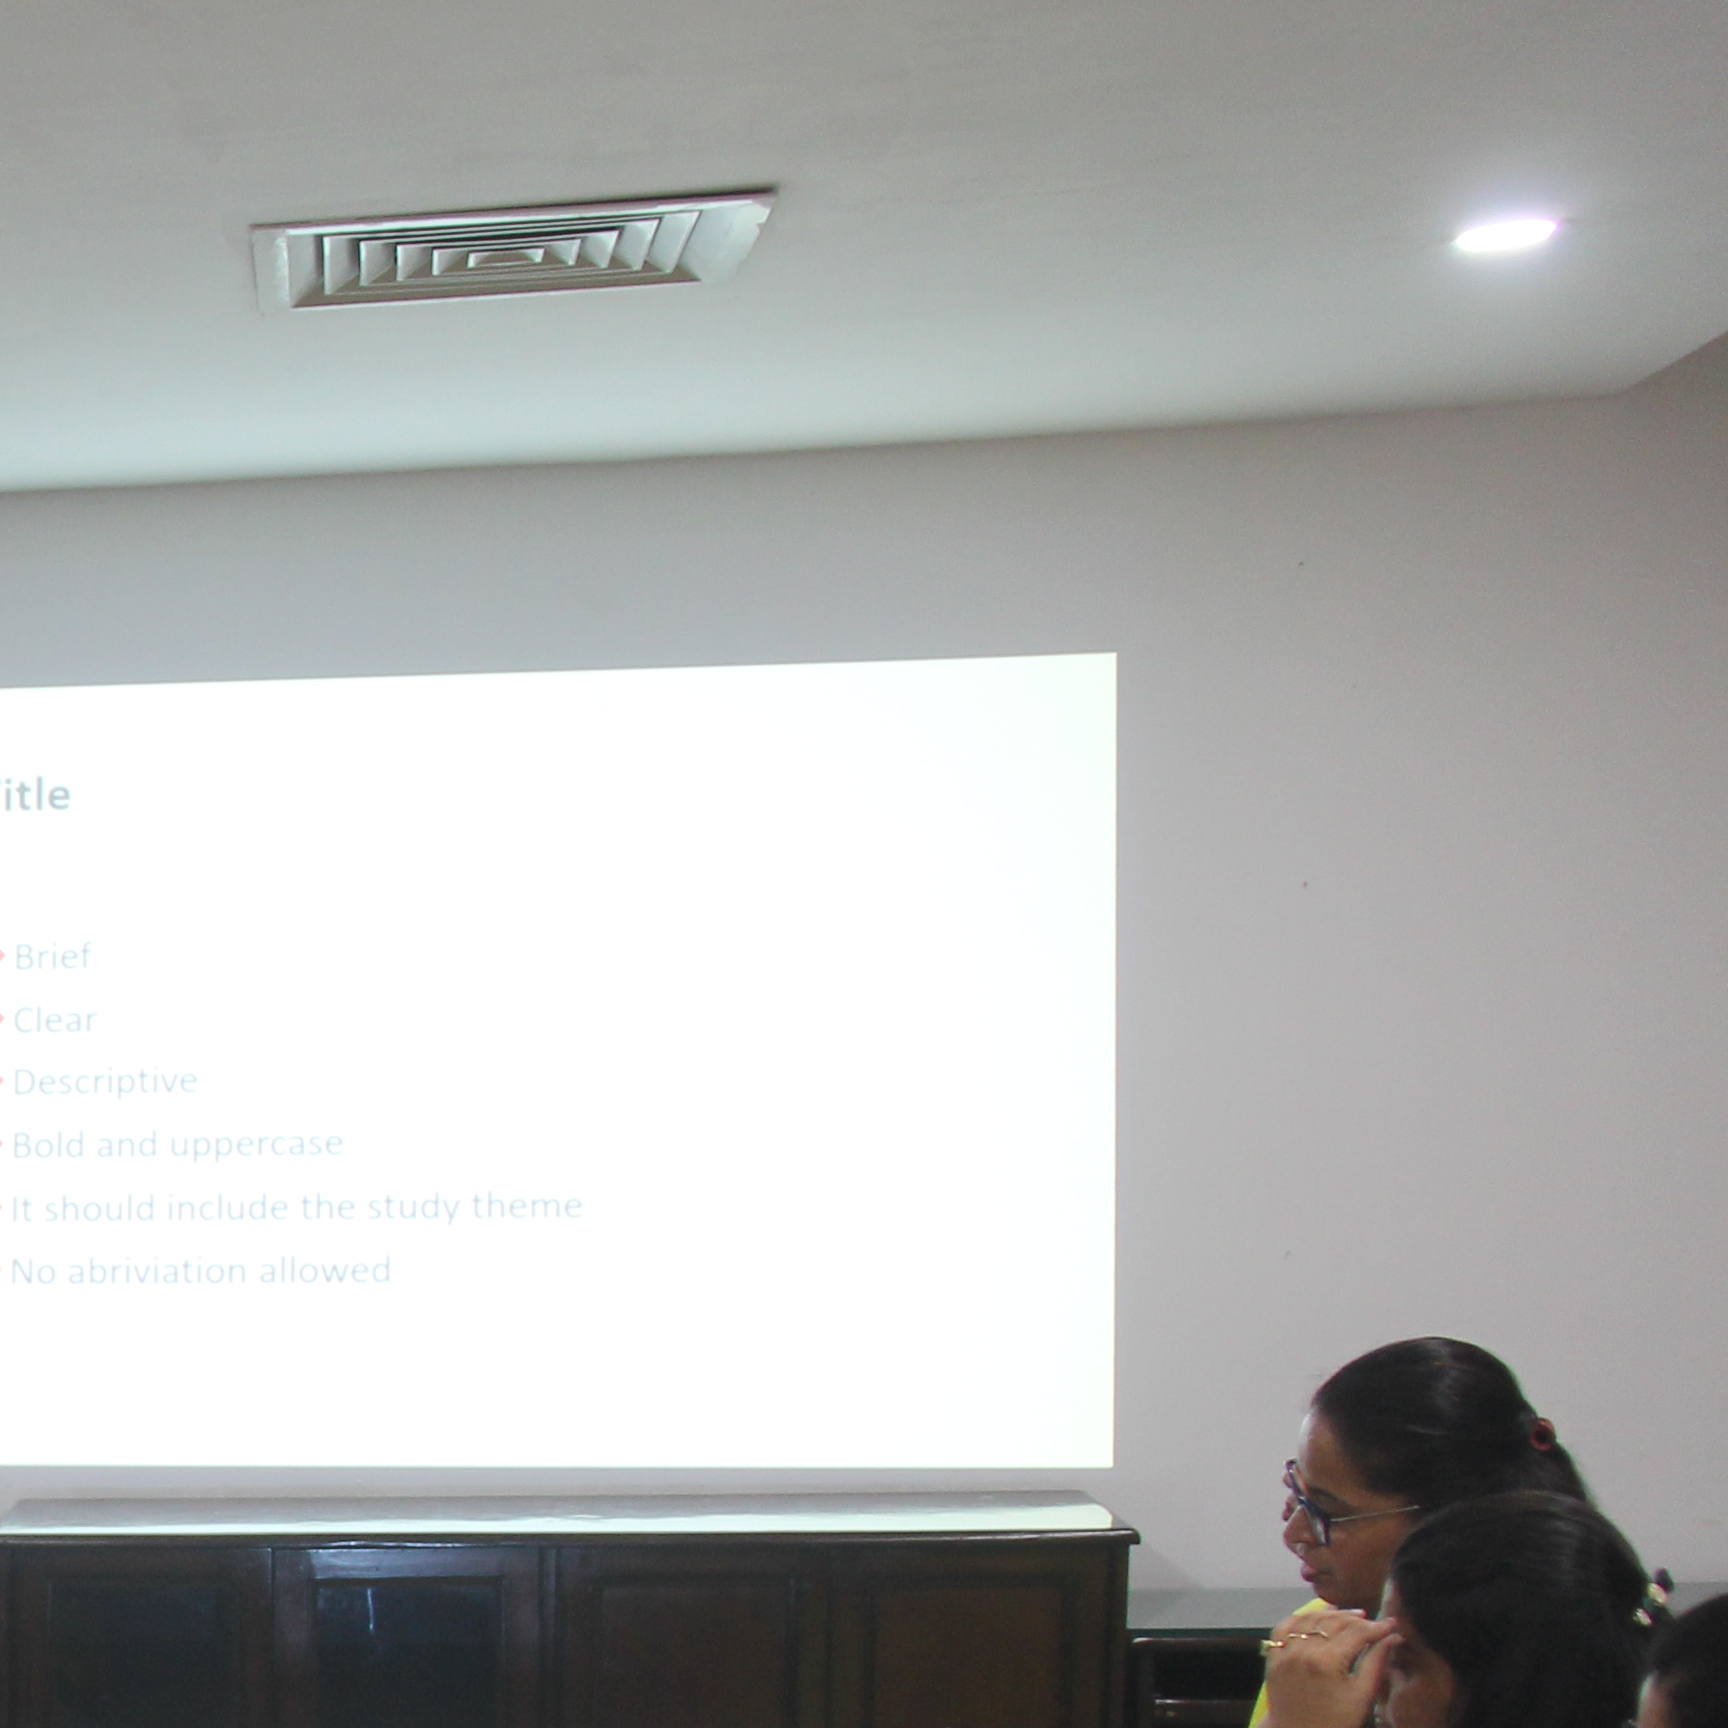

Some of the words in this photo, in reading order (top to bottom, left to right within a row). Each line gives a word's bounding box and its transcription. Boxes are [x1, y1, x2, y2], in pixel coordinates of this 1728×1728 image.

[15, 942, 93, 970] Brief
[13, 1006, 99, 1033] Clear
[14, 1066, 200, 1100] Descriptive
[12, 1131, 85, 1159] Bold
[96, 1131, 158, 1158] and
[170, 1134, 345, 1163] uppercase
[11, 1195, 34, 1223] It
[44, 1194, 155, 1222] should
[168, 1193, 289, 1221] include
[300, 1193, 356, 1221] the
[368, 1191, 461, 1225] study
[472, 1190, 584, 1220] theme
[9, 1258, 57, 1286] No
[67, 1256, 247, 1285] abriviation
[258, 1255, 393, 1285] allowed
